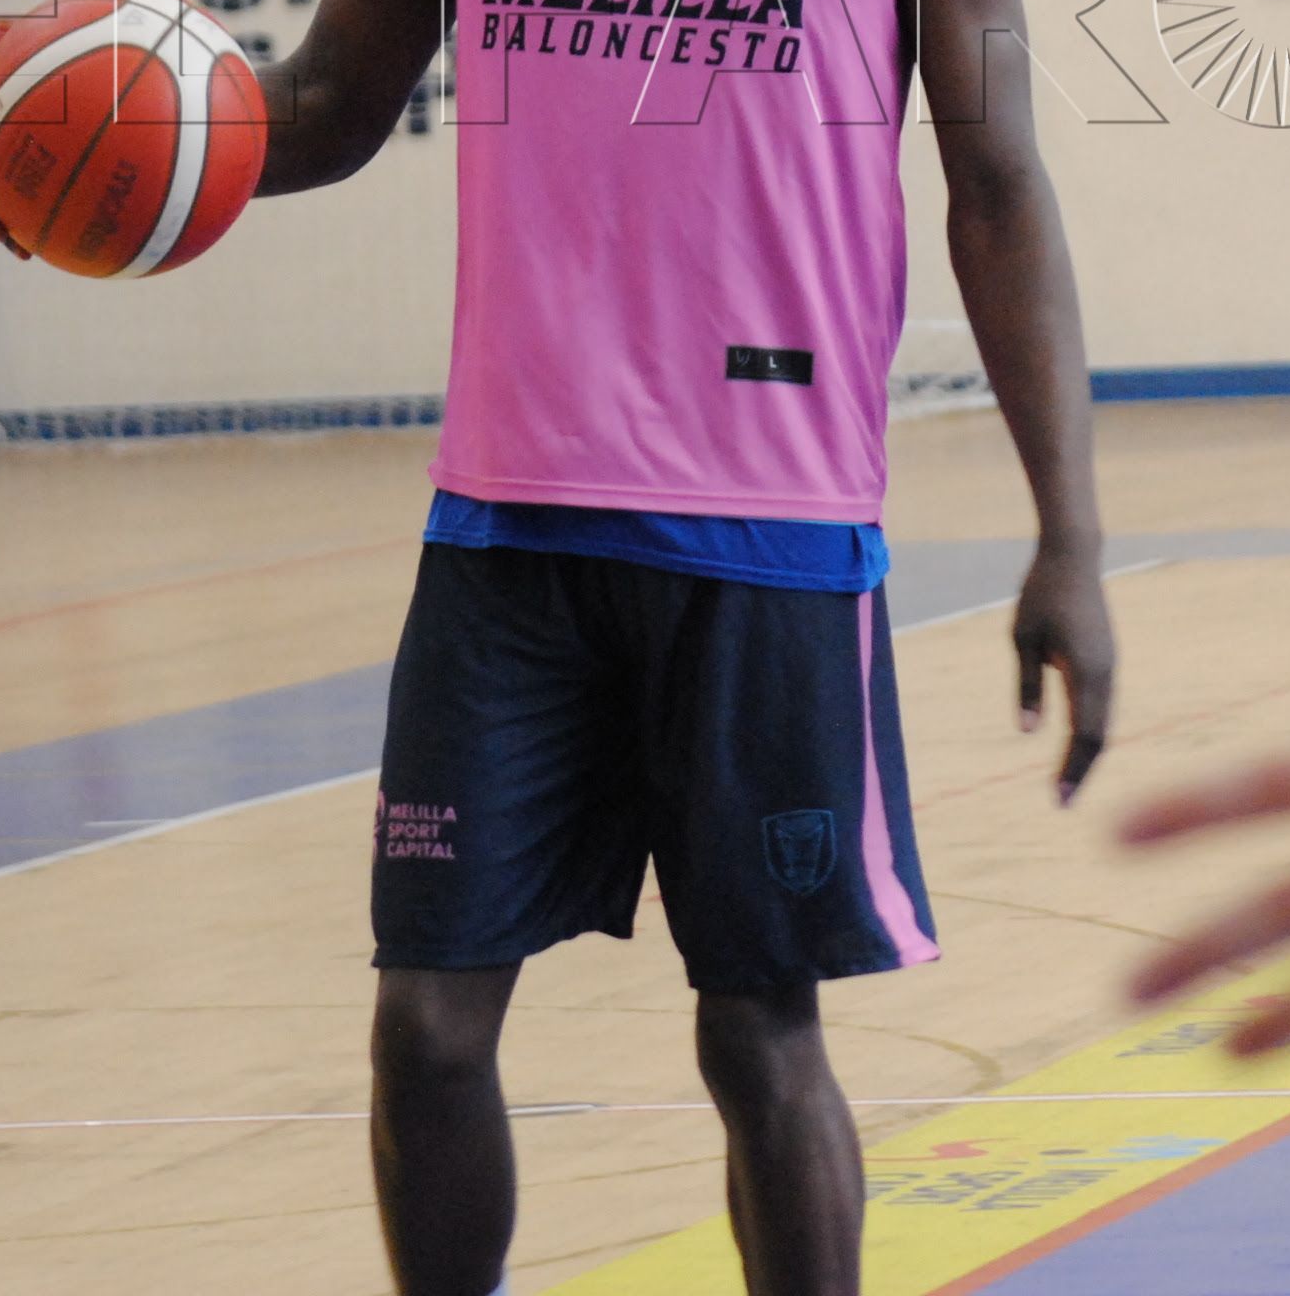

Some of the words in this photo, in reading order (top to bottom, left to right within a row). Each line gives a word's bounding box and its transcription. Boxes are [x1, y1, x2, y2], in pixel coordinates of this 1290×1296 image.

[482, 12, 801, 73] BALONCESTO
[388, 803, 457, 822] MELILLA
[387, 822, 441, 839] SPORT
[386, 841, 455, 860] CAPITAL
